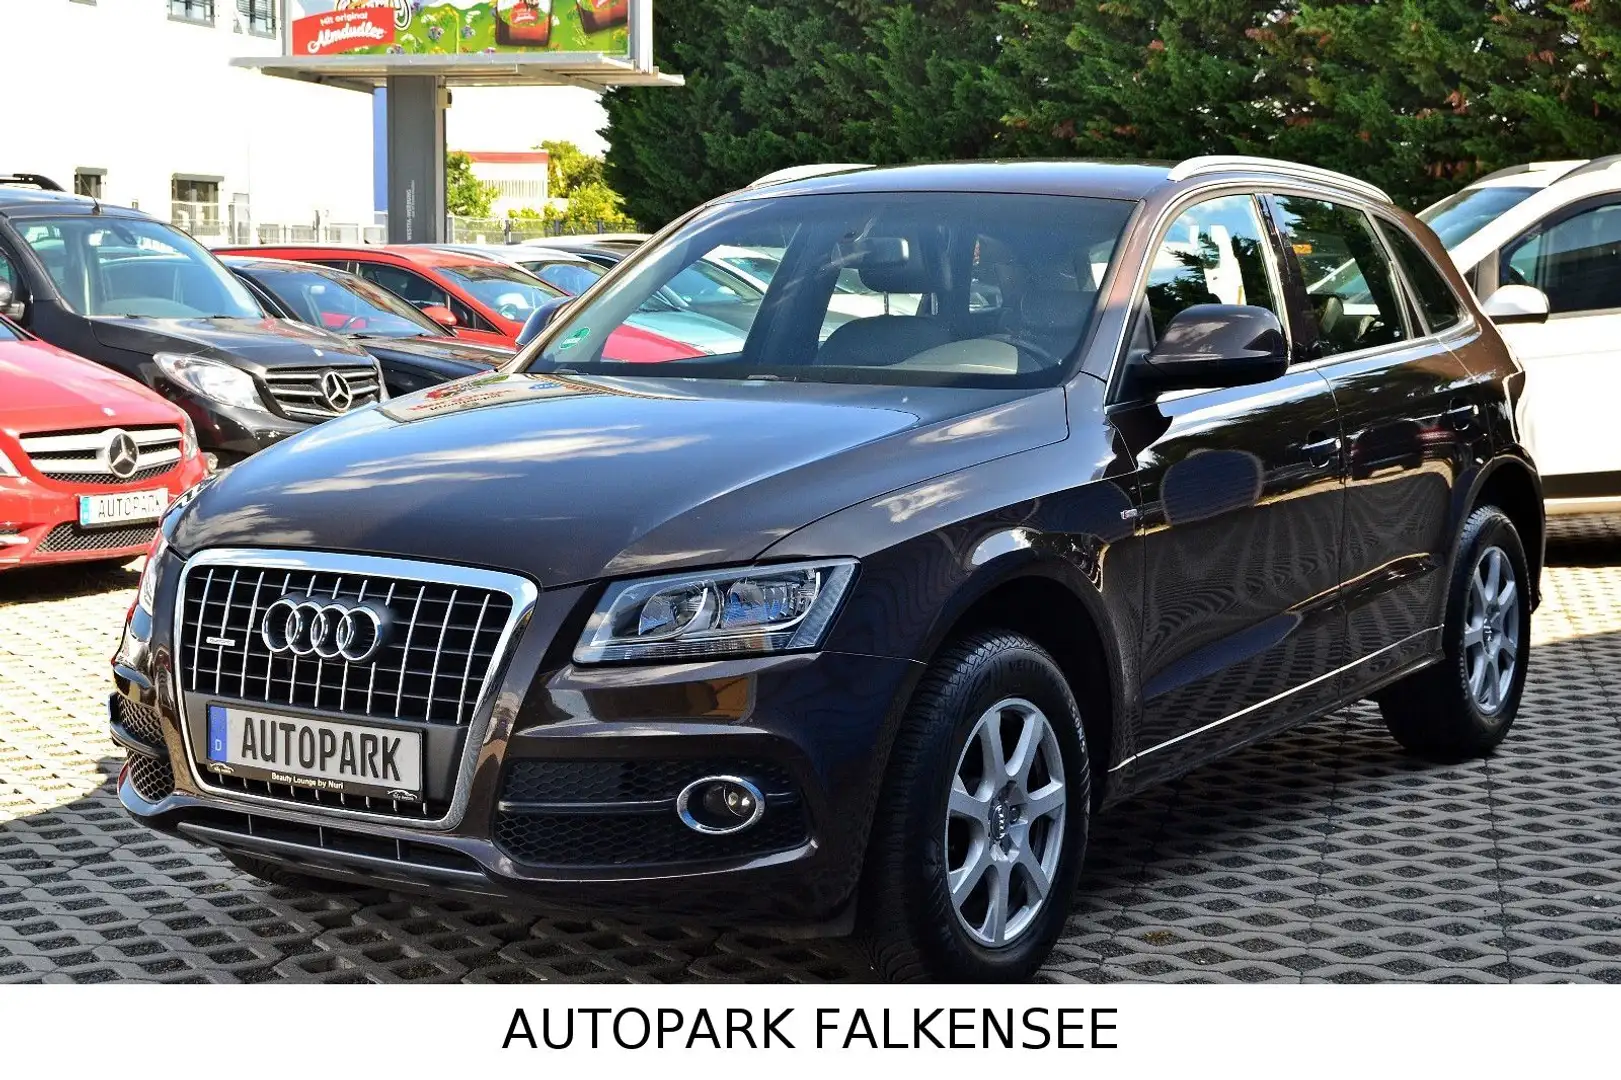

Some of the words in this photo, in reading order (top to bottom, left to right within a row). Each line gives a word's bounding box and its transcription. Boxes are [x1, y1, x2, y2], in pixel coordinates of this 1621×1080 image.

[320, 17, 334, 26] Mit
[335, 12, 368, 22] original
[307, 21, 387, 54] Almdudler
[214, 739, 221, 751] D
[241, 717, 401, 782] AUTOPARK
[271, 772, 293, 783] Beauty
[293, 775, 317, 787] Lounge
[317, 779, 327, 788] by
[328, 780, 344, 790] Nuri
